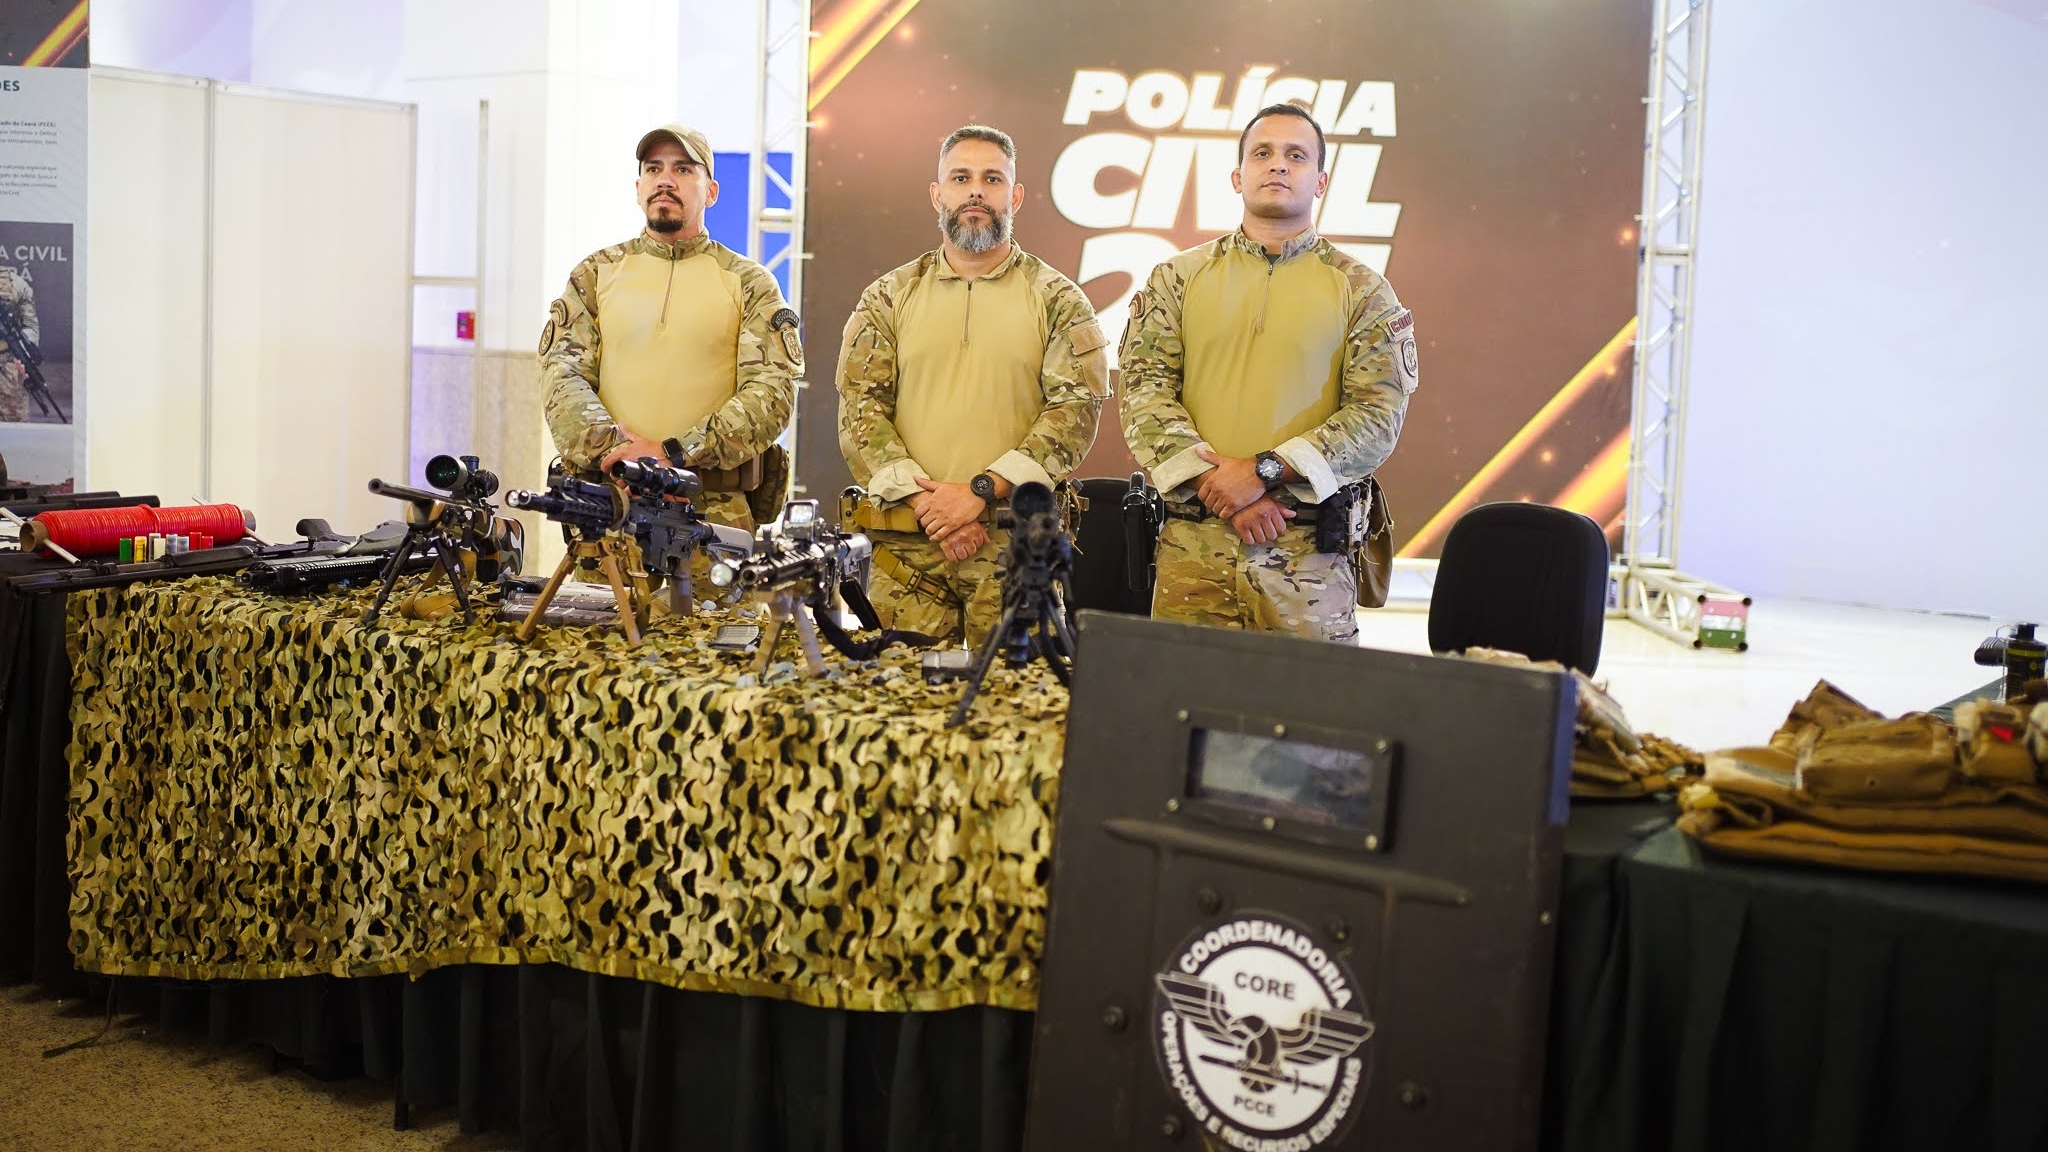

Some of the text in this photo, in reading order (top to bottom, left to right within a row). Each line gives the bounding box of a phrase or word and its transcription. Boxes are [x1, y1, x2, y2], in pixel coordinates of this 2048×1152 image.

[0, 80, 20, 92] ES
[15, 245, 67, 262] CIVIL
[1179, 920, 1352, 1009] COORDENADORIA
[1234, 972, 1296, 1000] CORE
[1161, 1010, 1210, 1122] OPERAÇÕES
[1309, 1056, 1362, 1145] ESPECIAIS
[1233, 1095, 1275, 1118] PCCE
